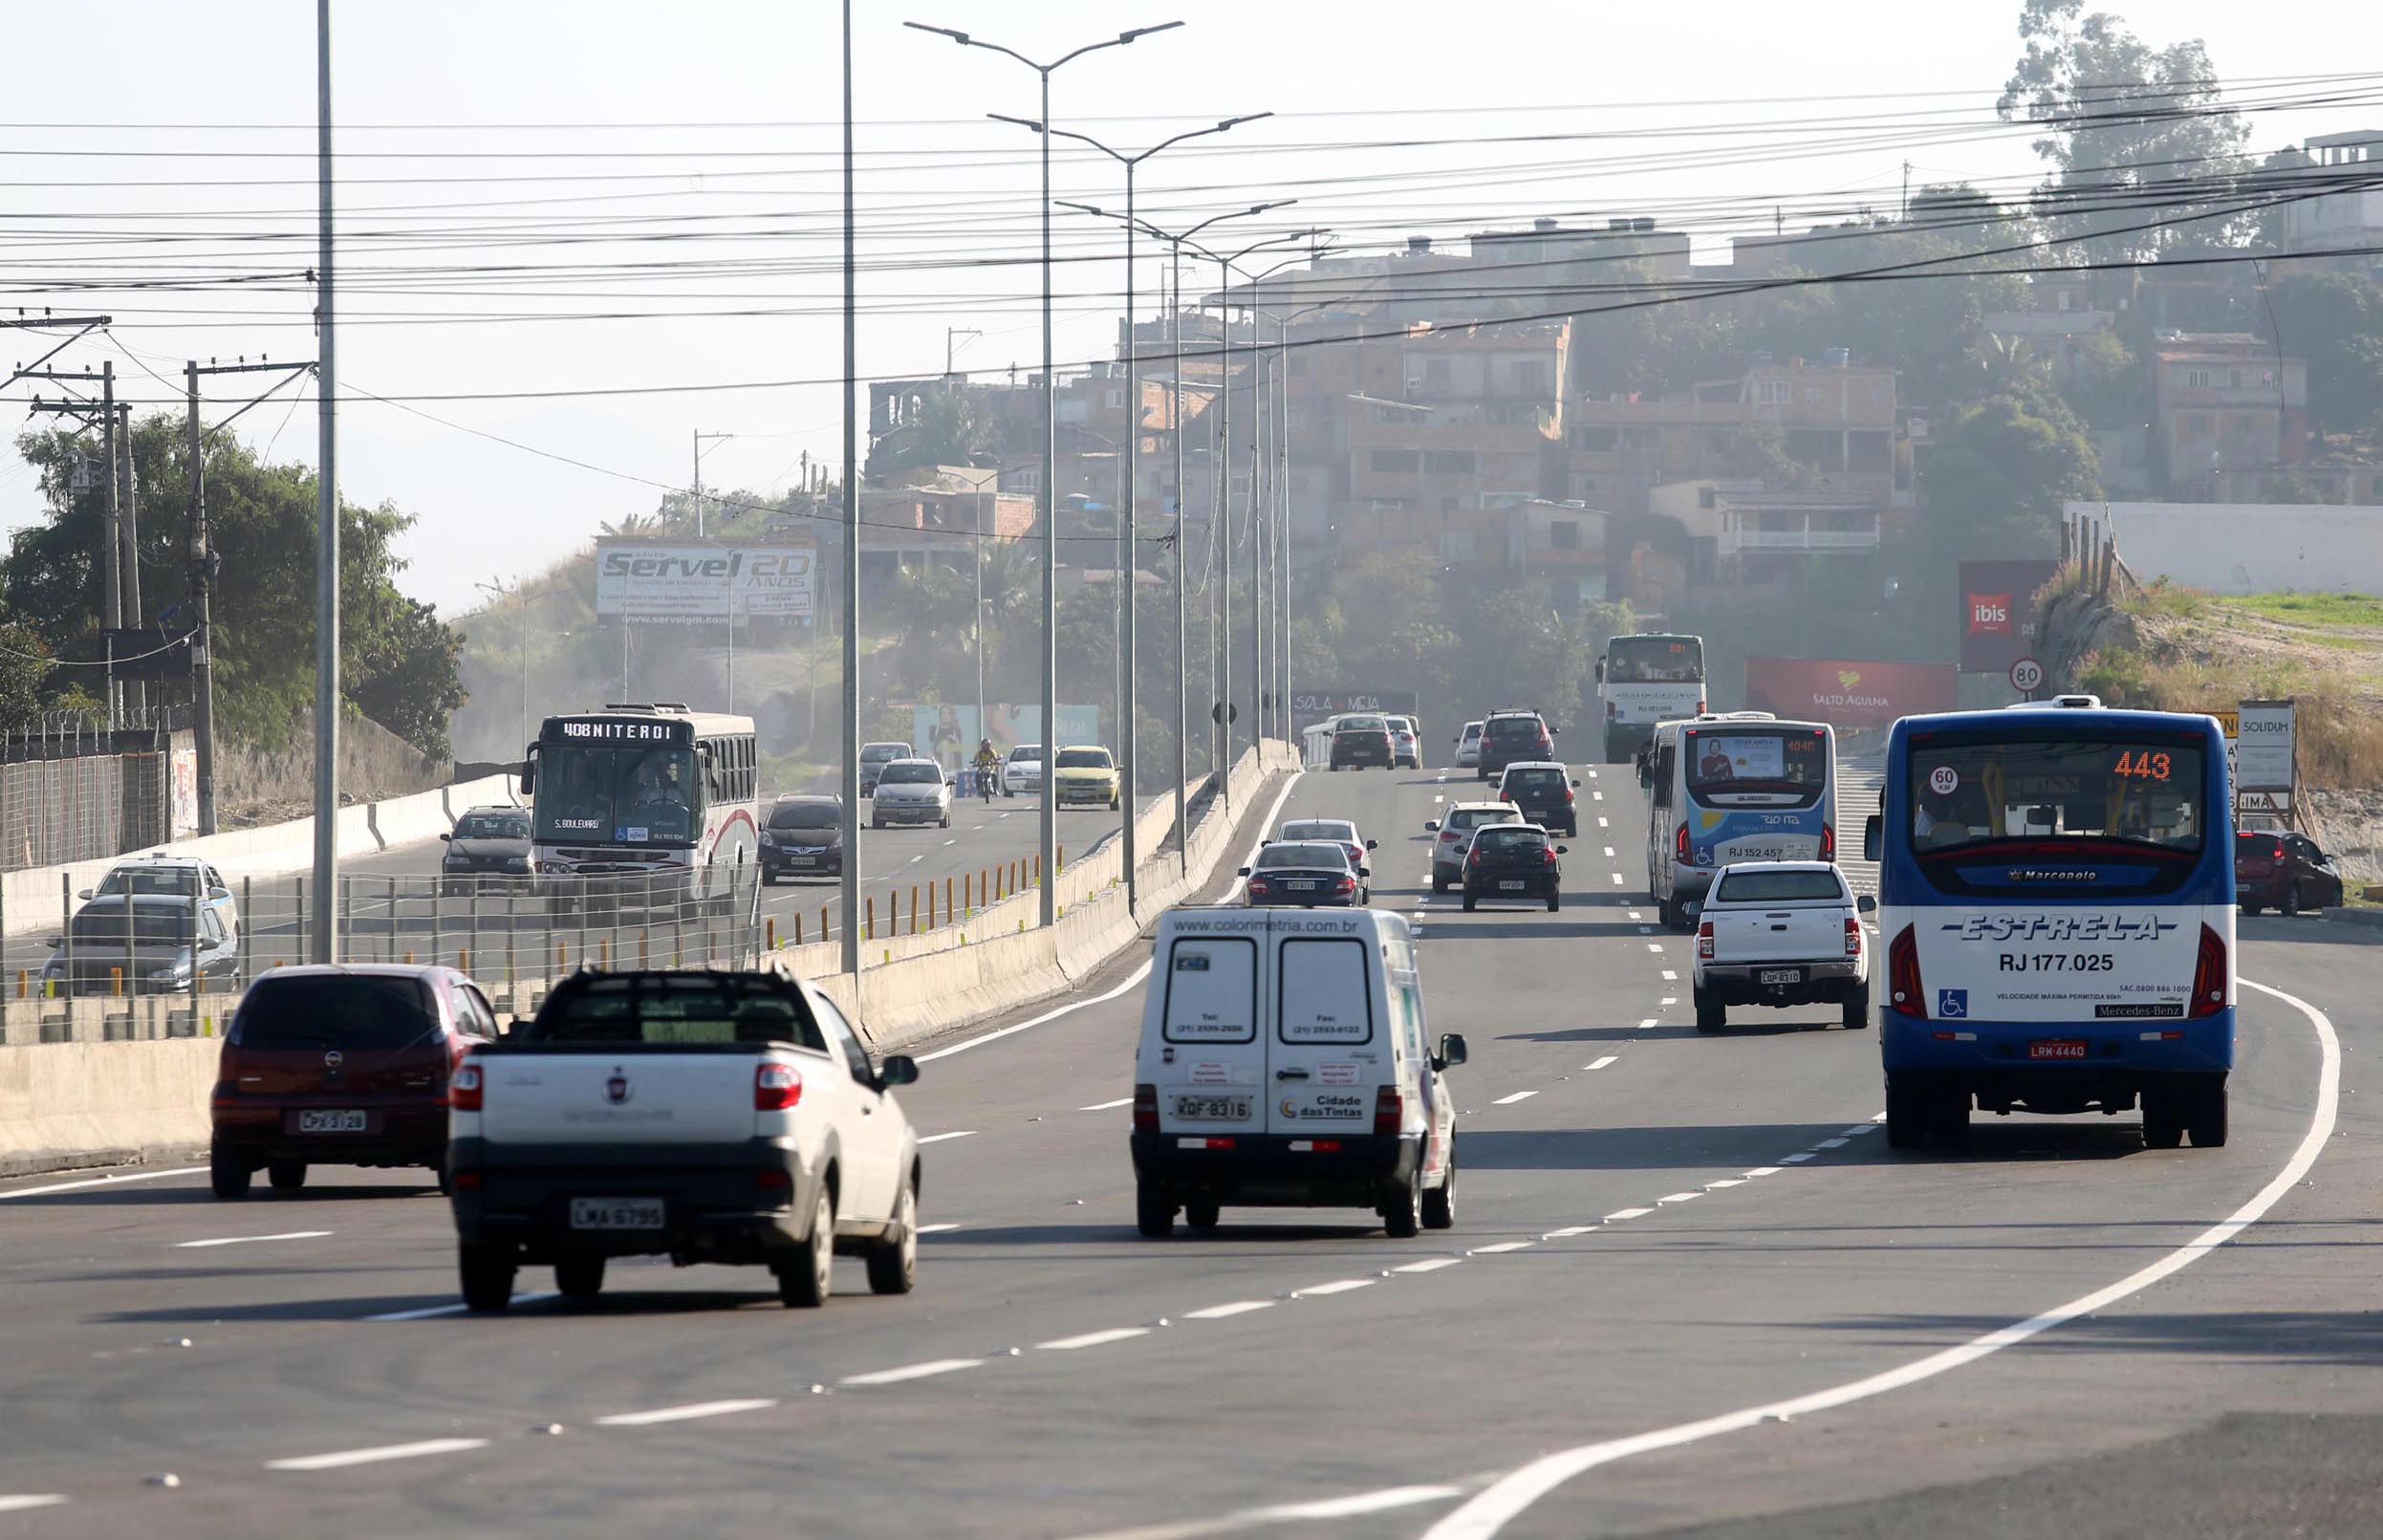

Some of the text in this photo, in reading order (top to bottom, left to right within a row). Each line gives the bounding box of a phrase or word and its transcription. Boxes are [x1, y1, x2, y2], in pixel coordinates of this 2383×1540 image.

[603, 551, 811, 577] Servel 20
[747, 576, 805, 588] ANOS
[1975, 604, 2006, 622] ibis
[2016, 667, 2038, 682] 80
[1812, 693, 1889, 706] SALTO AGULHA
[564, 723, 670, 740] 408 NITEROI
[2243, 721, 2288, 732] SOLIDUM
[2114, 750, 2170, 780] 443
[1936, 770, 1954, 783] 60
[1729, 847, 1743, 857] RJ
[2025, 870, 2096, 880] Marcopolo
[1174, 920, 1358, 933] www.colorimetria.com.br
[1960, 913, 2161, 942] ESTRELA
[1999, 953, 2114, 971] RJ 177.025
[2100, 1006, 2180, 1016] Mercedes-Benz
[1316, 1095, 1361, 1106] Cidade
